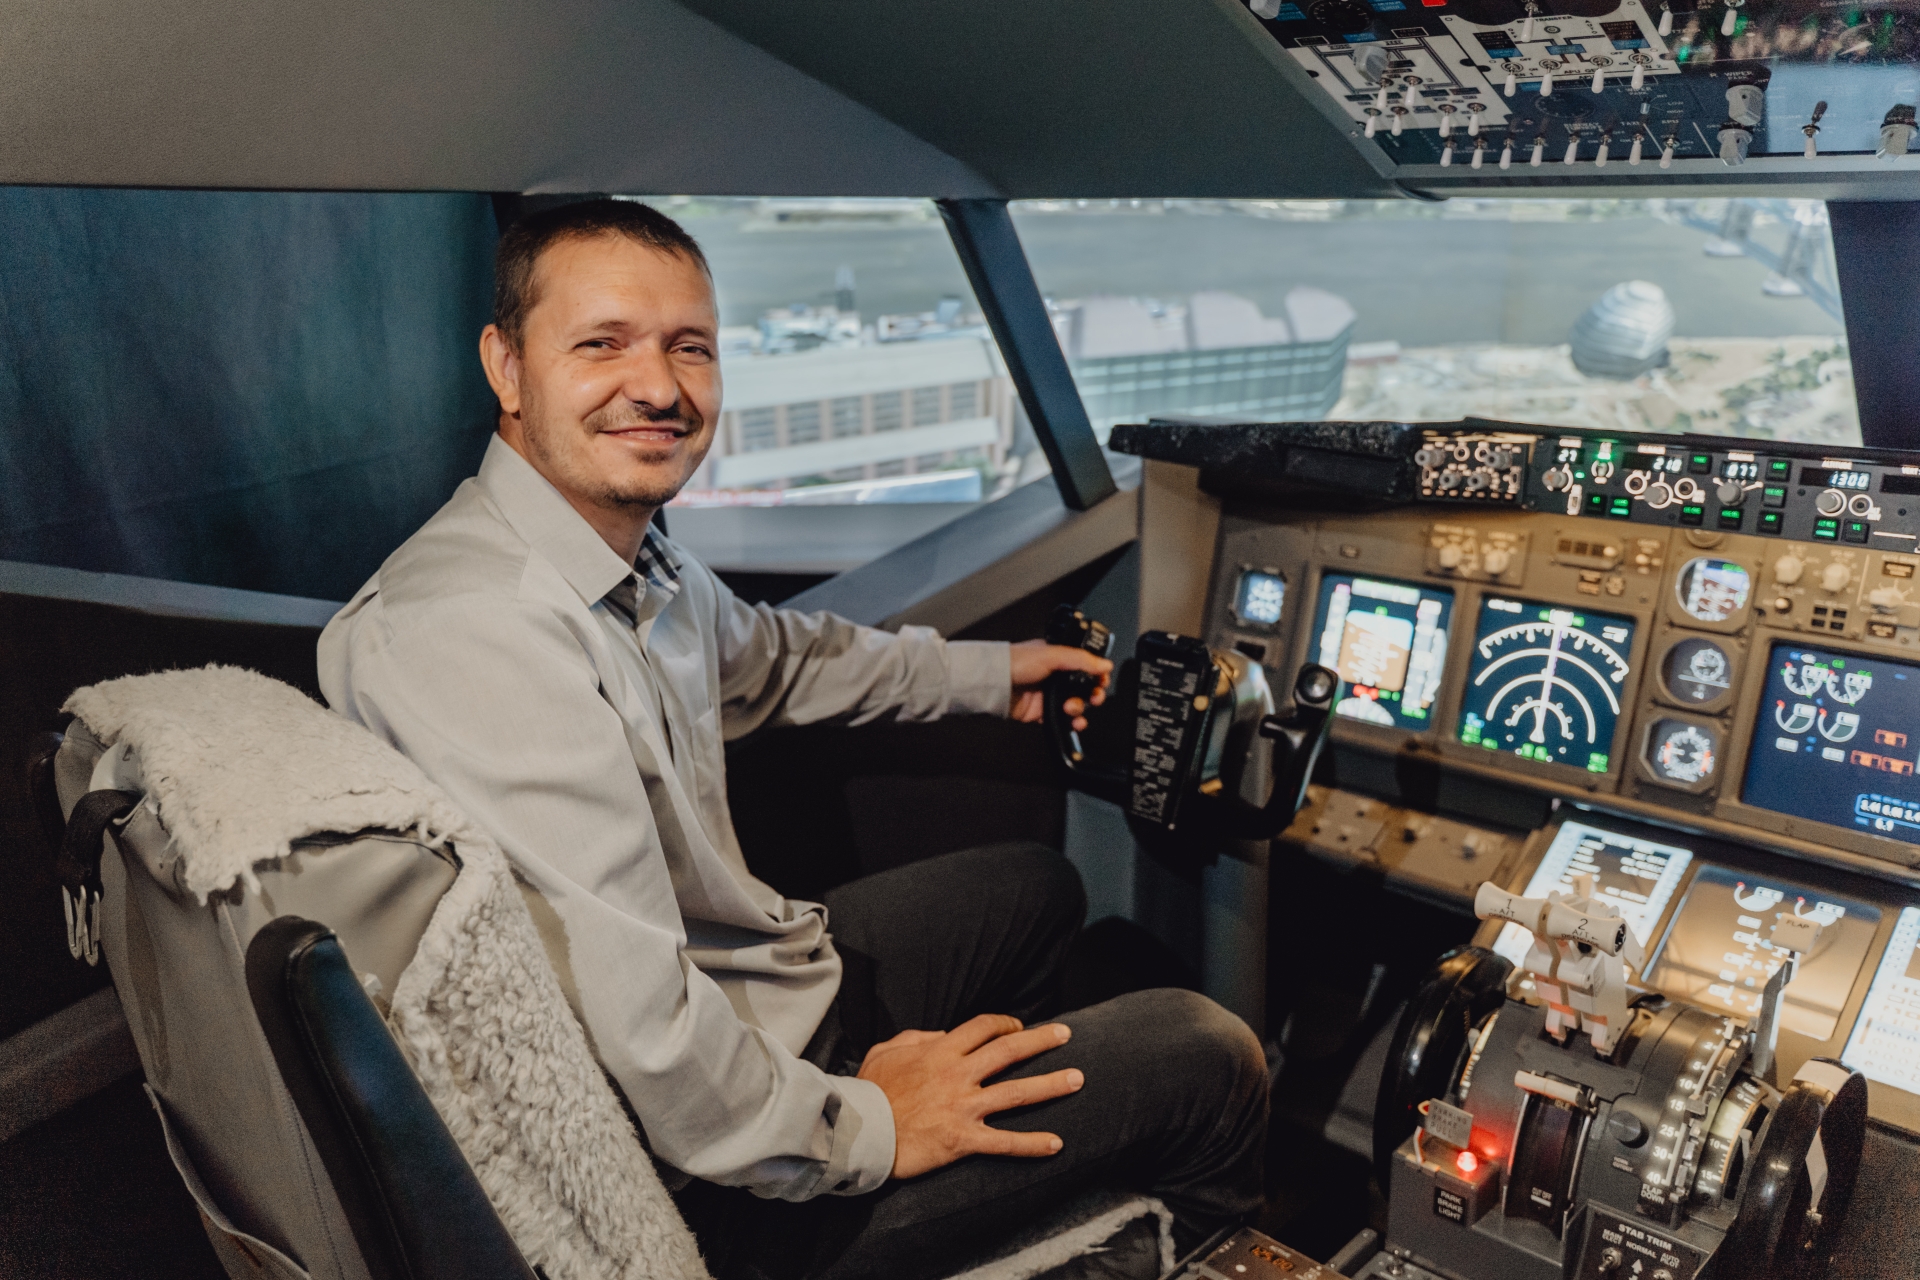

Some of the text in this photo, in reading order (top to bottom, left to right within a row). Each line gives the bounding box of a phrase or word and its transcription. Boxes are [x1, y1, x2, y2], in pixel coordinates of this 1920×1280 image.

[1535, 15, 1573, 23] TRANSFER
[1830, 470, 1871, 490] 1300
[1506, 898, 1513, 910] 1
[1499, 908, 1516, 918] A/T
[1577, 918, 1589, 931] 2
[1786, 919, 1810, 929] FLAP
[1572, 929, 1590, 939] A/T
[1703, 1041, 1714, 1051] 2
[1692, 1061, 1702, 1071] 5
[1679, 1078, 1693, 1090] 10
[1670, 1098, 1684, 1112] 15
[1659, 1123, 1675, 1138] 25
[1709, 1139, 1720, 1149] 10
[1652, 1145, 1668, 1160] 30
[1646, 1171, 1662, 1185] 40
[1701, 1169, 1713, 1180] 15
[1642, 1183, 1663, 1195] FLAP
[1440, 1190, 1462, 1205] PARK
[1640, 1190, 1665, 1204] DOWN
[1437, 1197, 1463, 1214] BRAKE
[1438, 1205, 1462, 1221] LIGHT
[1618, 1223, 1672, 1251] STAB TRIM
[1625, 1240, 1657, 1259] NORMAL
[1661, 1252, 1680, 1263] AUTO
